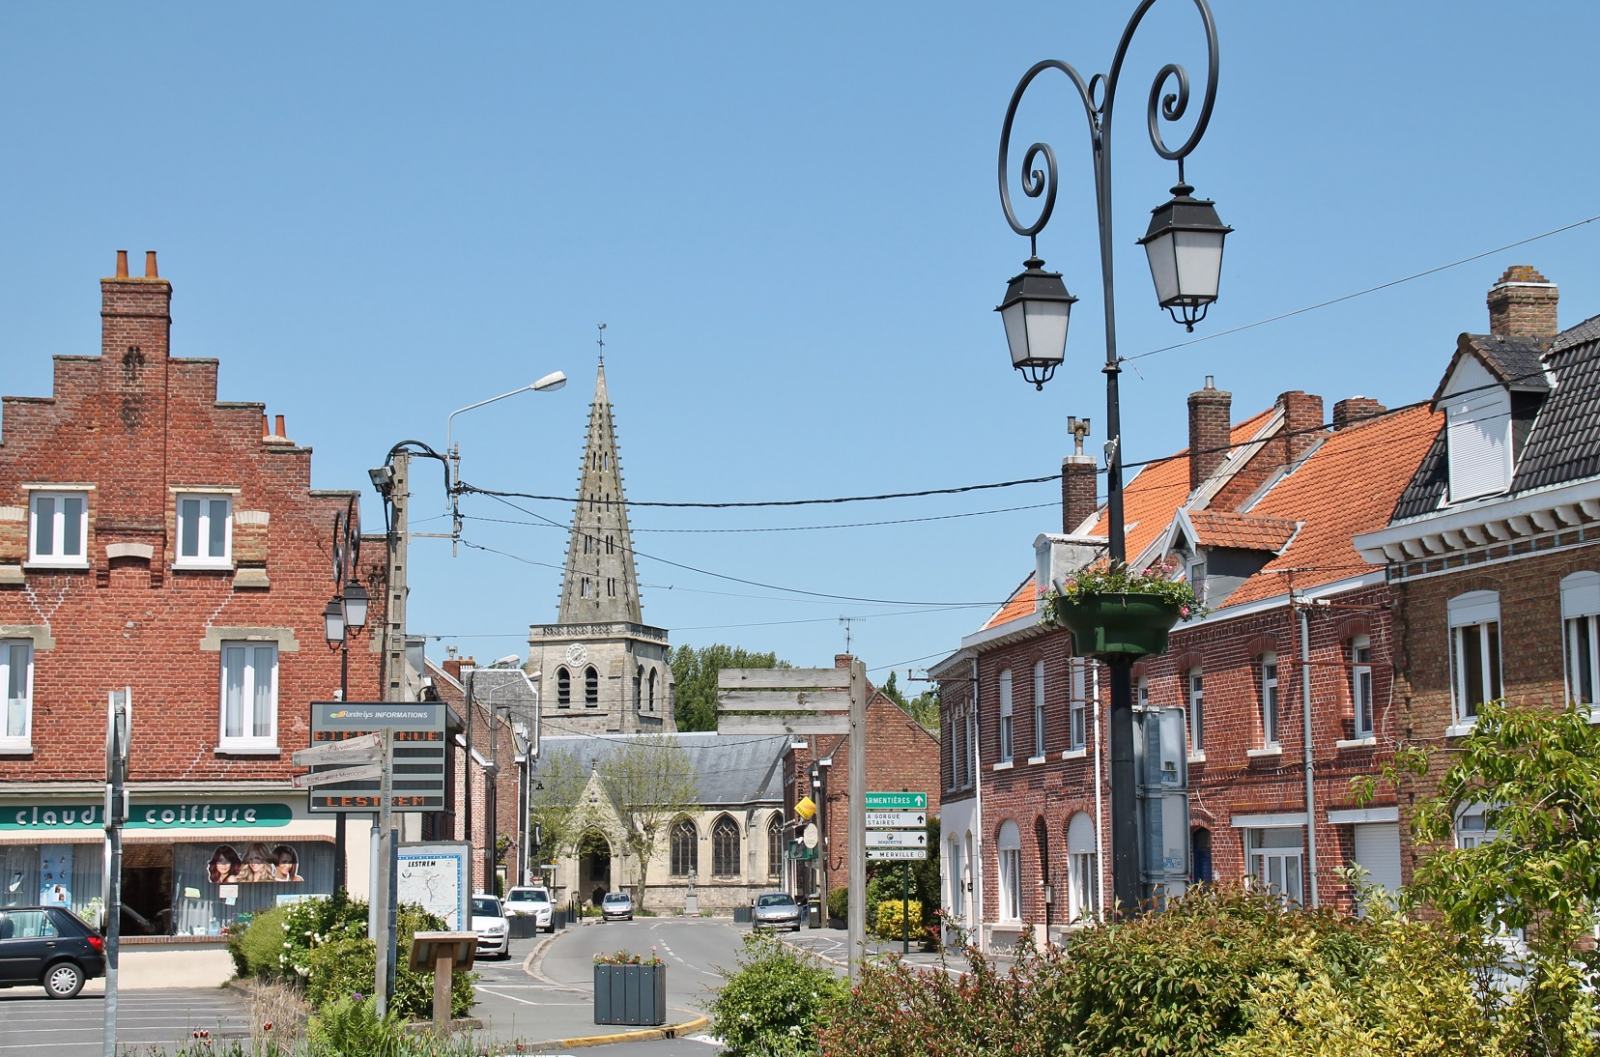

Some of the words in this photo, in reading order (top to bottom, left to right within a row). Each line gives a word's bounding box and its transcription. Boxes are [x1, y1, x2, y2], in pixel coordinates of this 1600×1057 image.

[375, 711, 428, 719] INFORMATIONS
[16, 806, 105, 826] claud
[145, 805, 257, 824] coiffure
[408, 860, 436, 868] LESTREM
